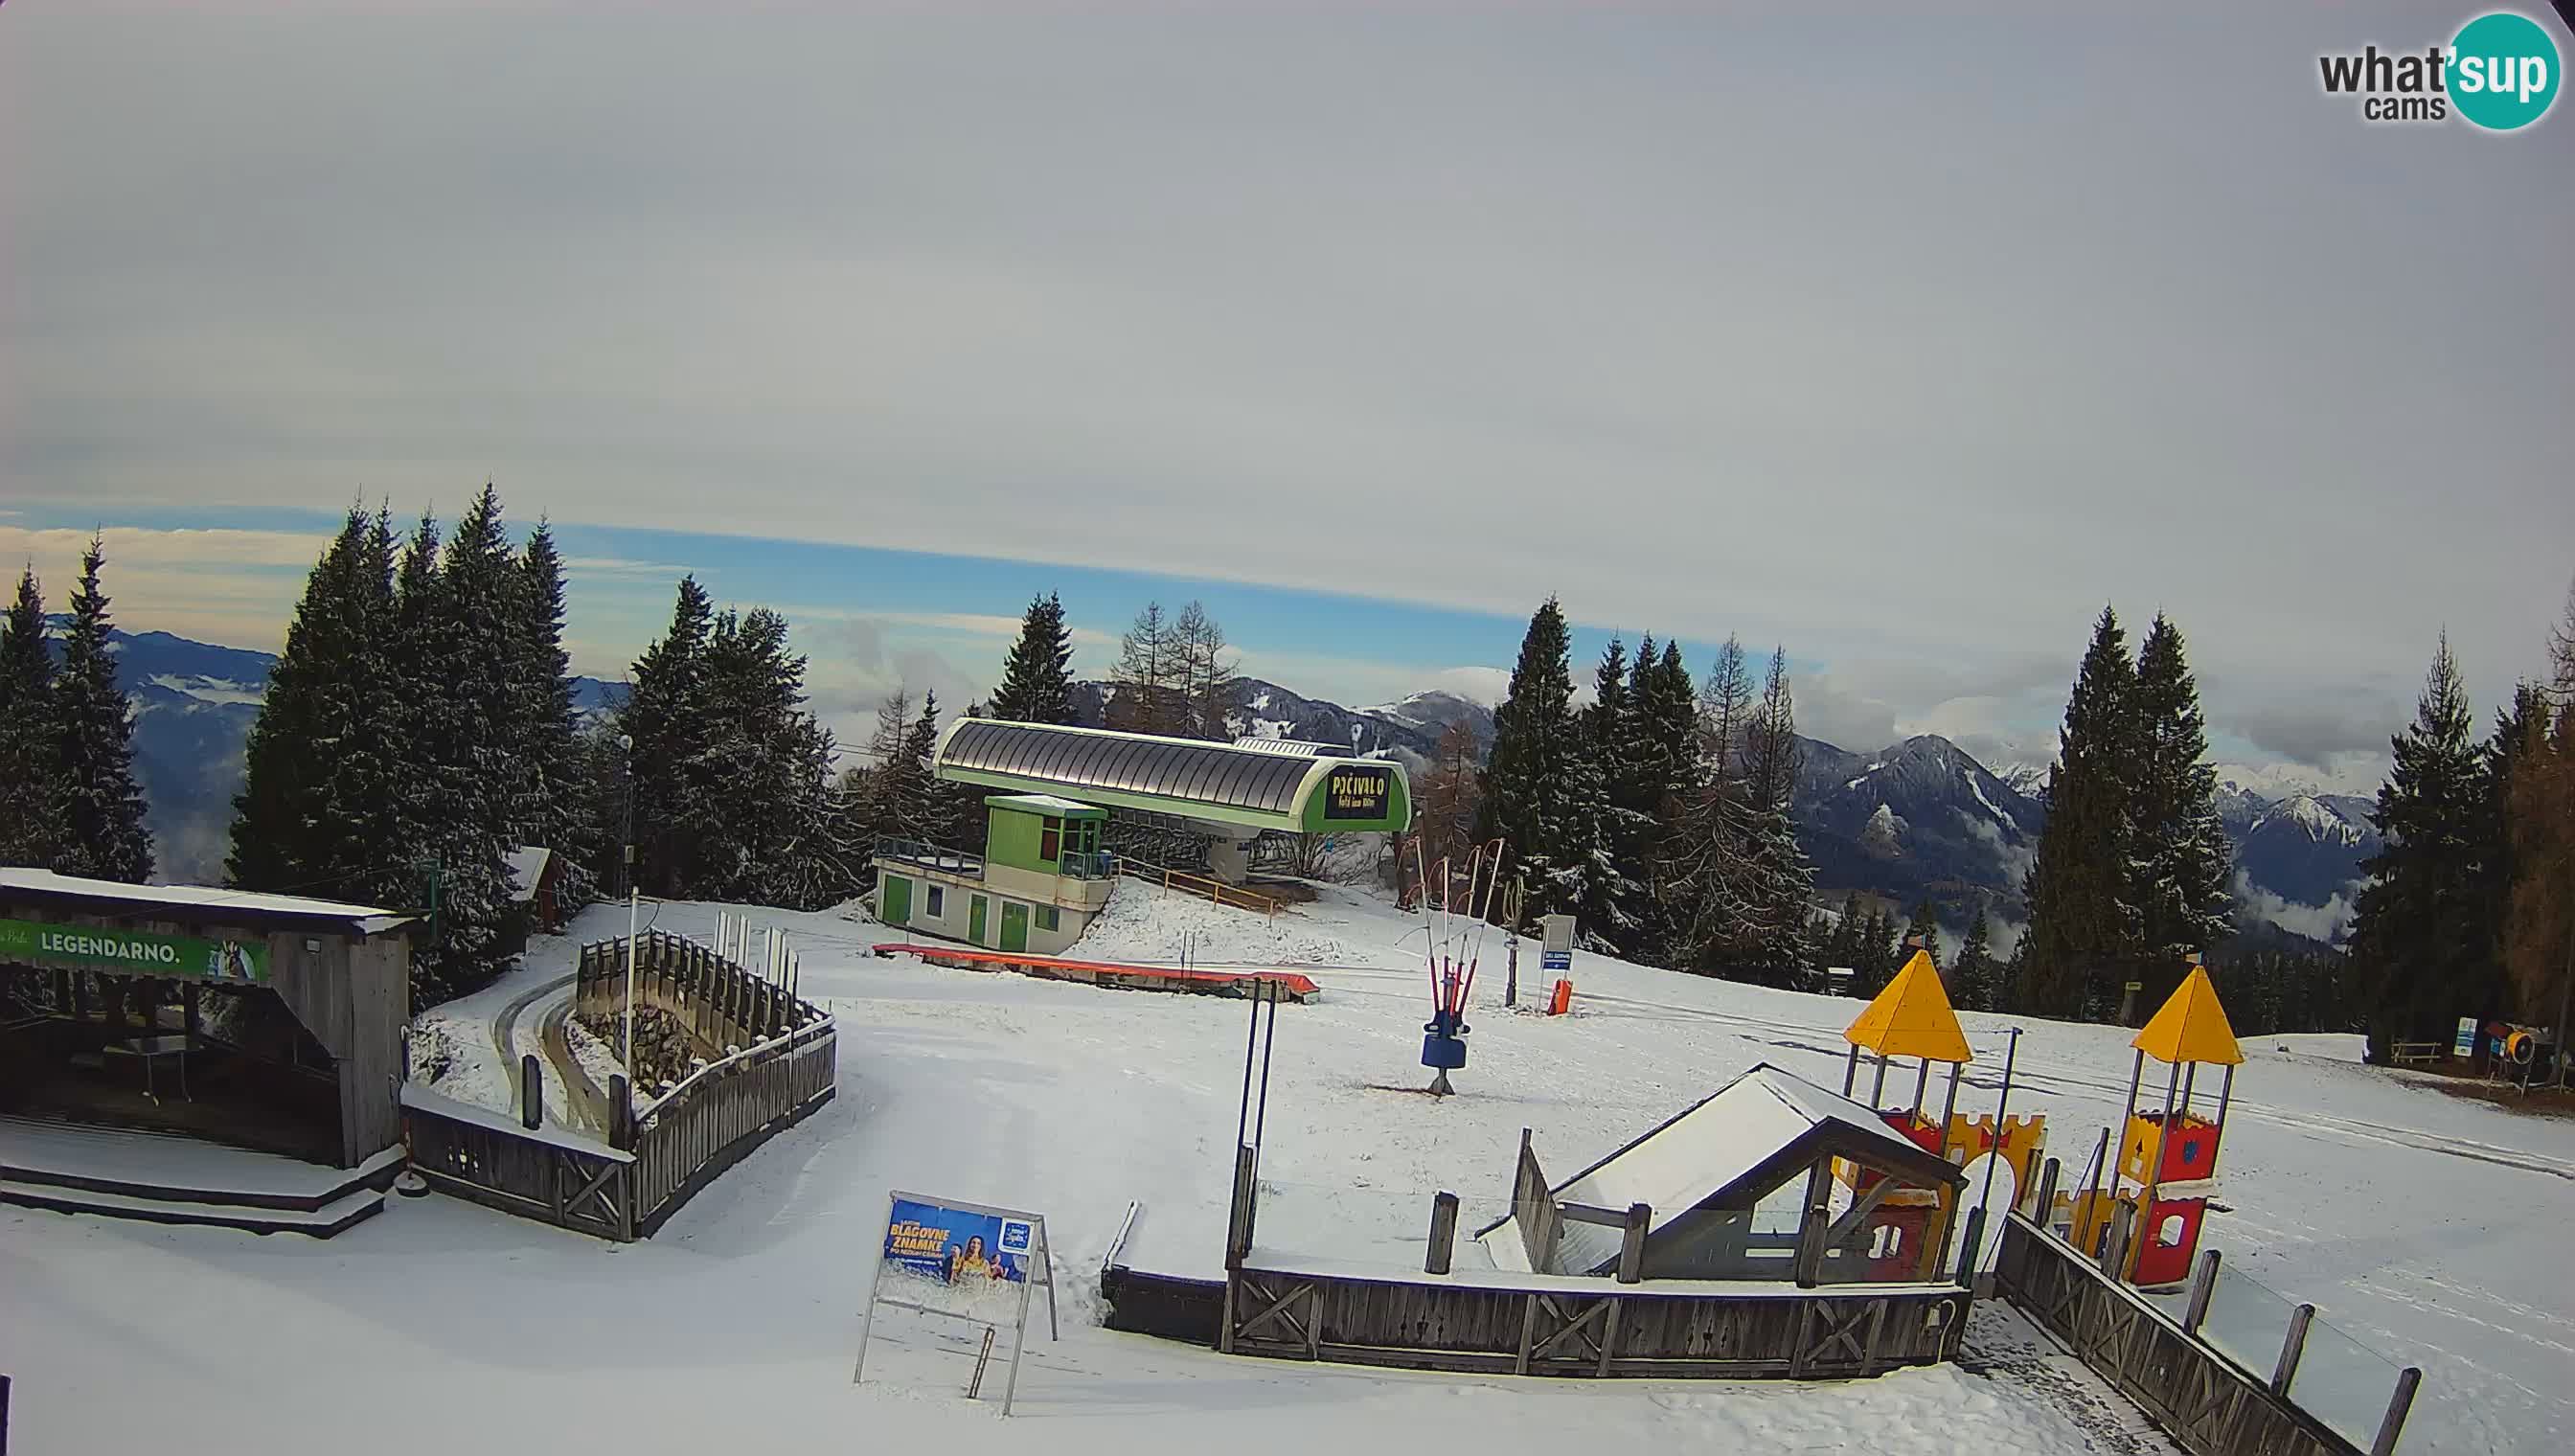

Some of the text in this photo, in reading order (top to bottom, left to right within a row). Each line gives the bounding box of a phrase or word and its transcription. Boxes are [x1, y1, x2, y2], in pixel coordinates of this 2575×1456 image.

[41, 932, 181, 964] LEGENDARNO.
[890, 1224, 950, 1241] BLAGOVNE
[893, 1237, 943, 1251] ZNAMKE
